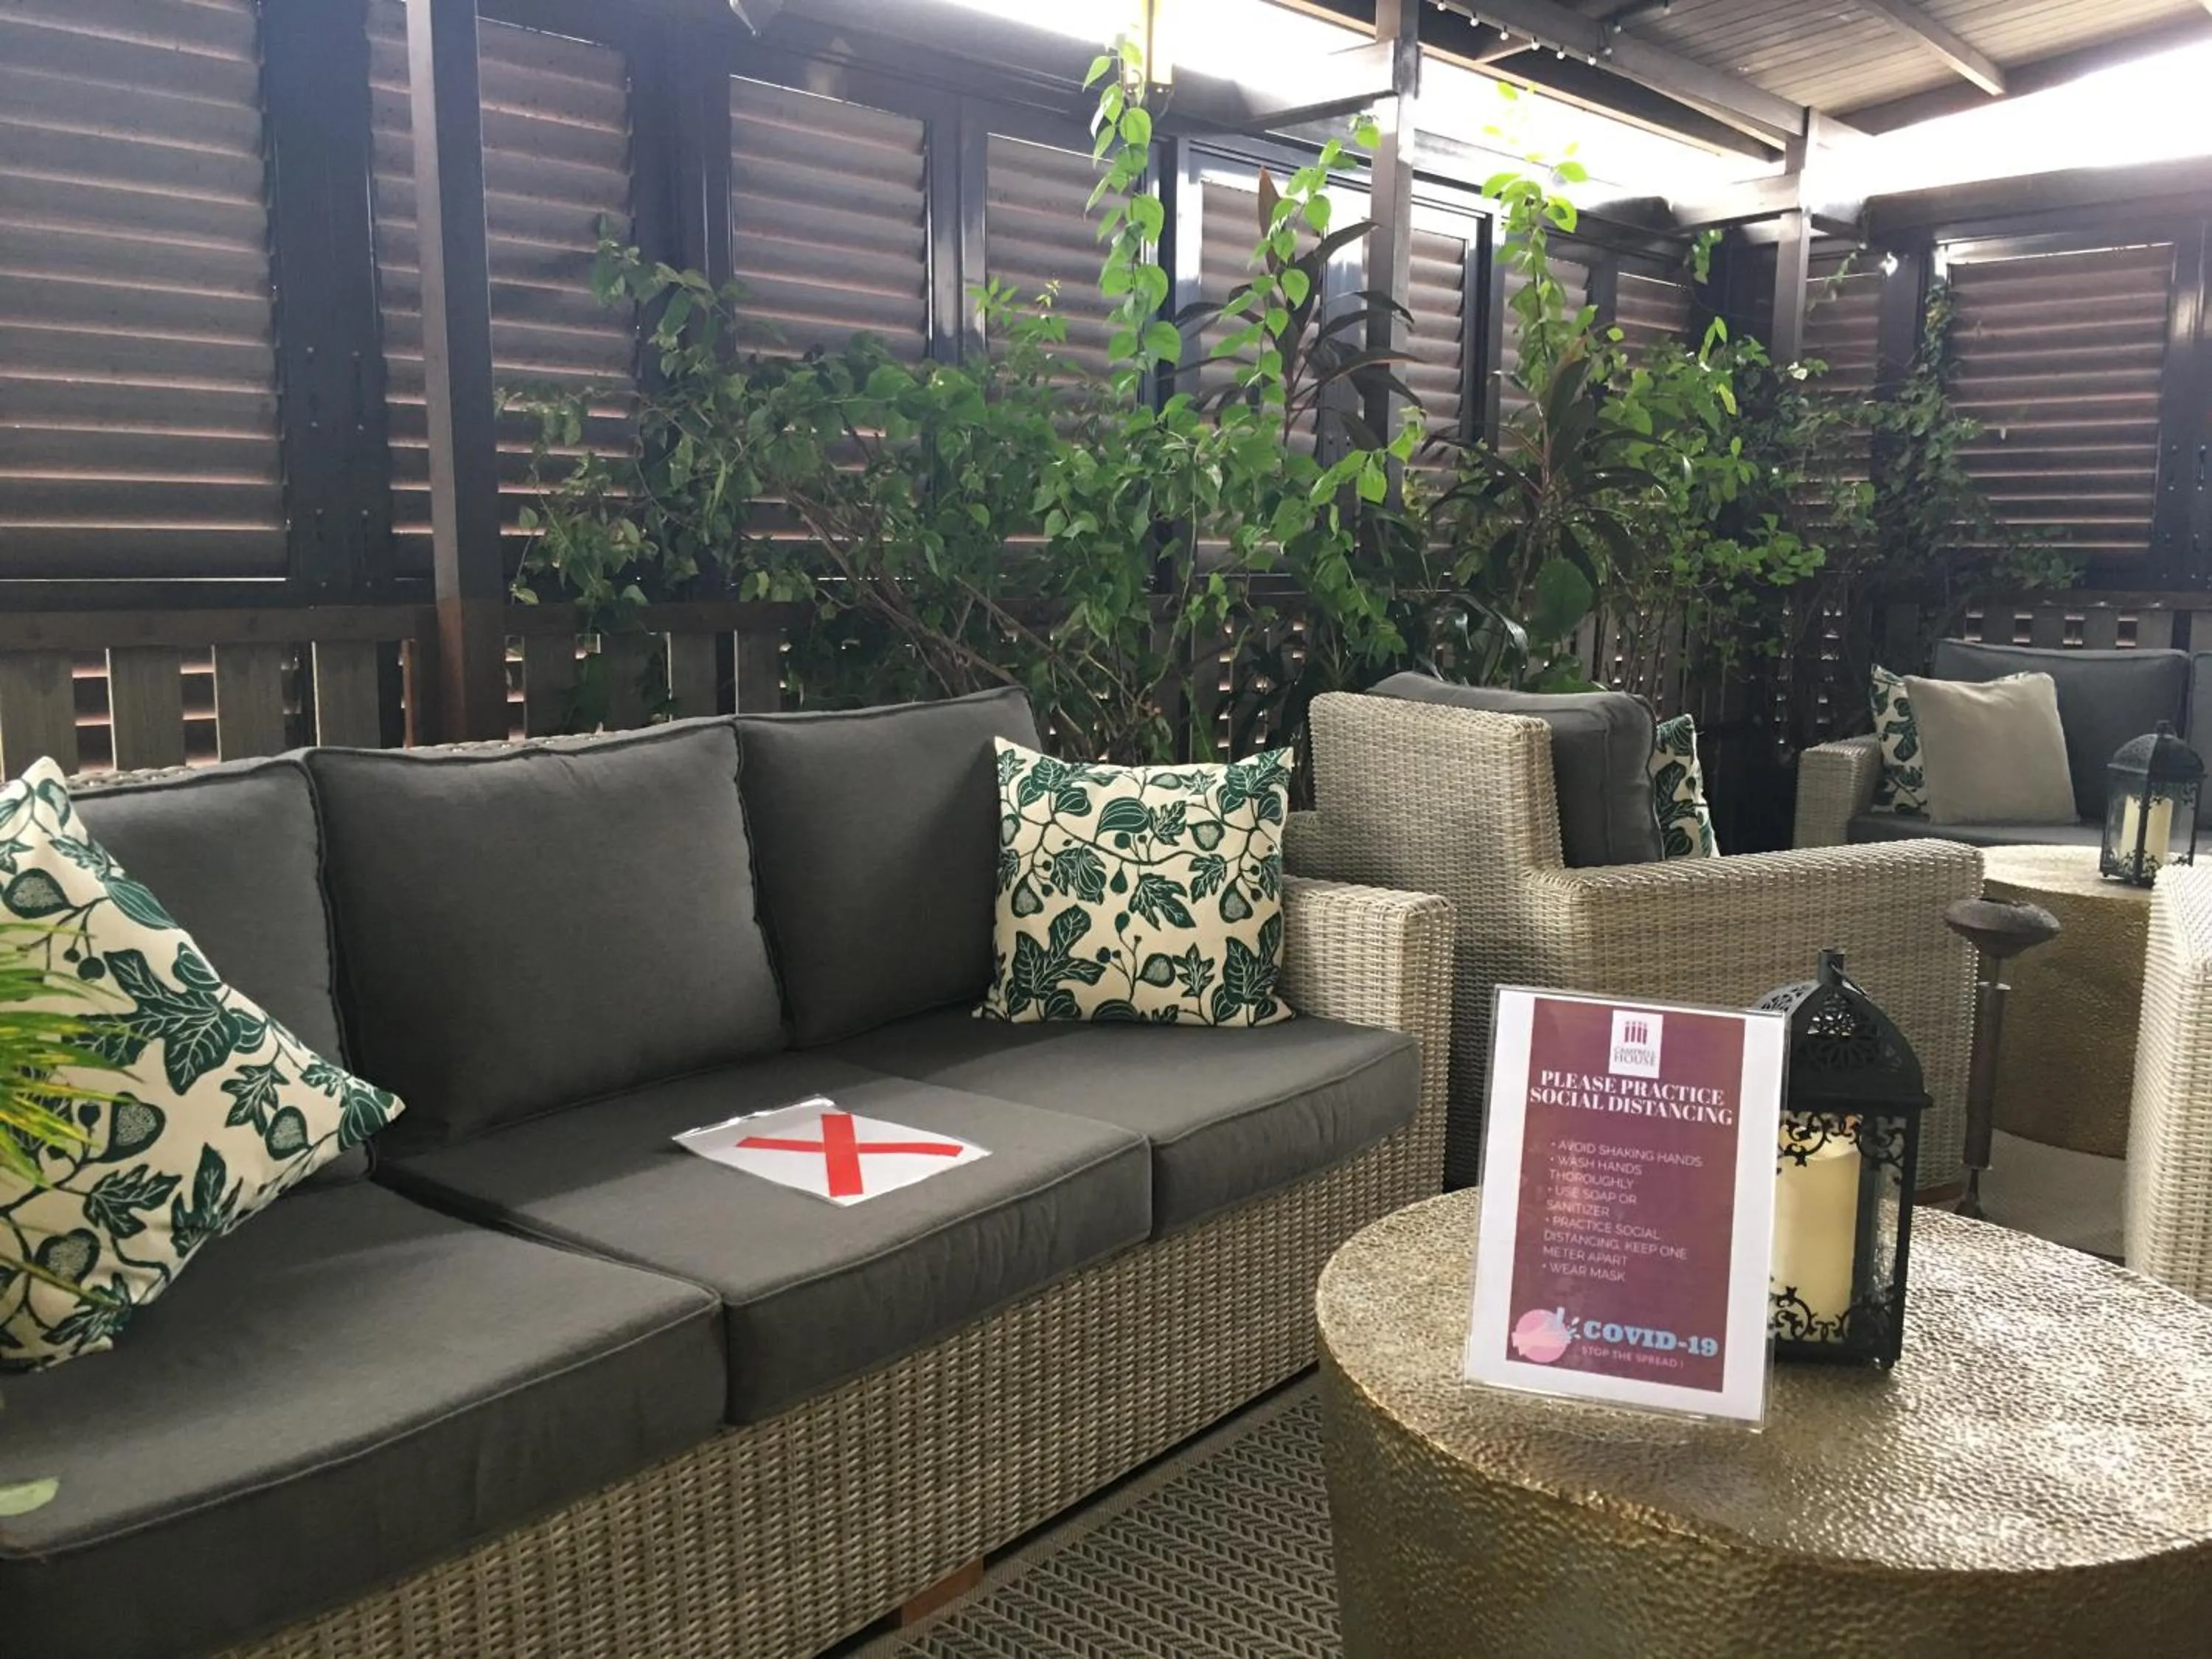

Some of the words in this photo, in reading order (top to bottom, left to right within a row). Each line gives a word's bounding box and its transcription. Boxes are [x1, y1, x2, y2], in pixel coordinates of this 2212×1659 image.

[1613, 1052, 1655, 1067] HOUSE
[1540, 1070, 1616, 1094] PLEASE
[1621, 1079, 1725, 1106] PRACTICE
[1529, 1087, 1604, 1110] SOCIAL
[1608, 1096, 1733, 1125] DISTANCING
[1557, 1140, 1596, 1155] AVOID
[1598, 1144, 1654, 1161] SHAKING
[1657, 1152, 1703, 1167] HANDS
[1557, 1155, 1595, 1169] WASH
[1598, 1161, 1642, 1176] HANDS
[1549, 1169, 1634, 1190] THOROUGHLY
[1555, 1185, 1579, 1199] USE
[1582, 1188, 1616, 1203] SOAP
[1618, 1193, 1638, 1205] OR
[1546, 1199, 1610, 1217] SANITIZER
[1552, 1215, 1612, 1234] PRACTICE
[1615, 1223, 1661, 1240] SOCIAL
[1543, 1245, 1585, 1262] METER
[1587, 1251, 1628, 1267] APART
[1624, 1241, 1658, 1254] KEEP
[1659, 1245, 1688, 1260] ONE
[1549, 1262, 1587, 1276] WEAR
[1590, 1267, 1626, 1282] MASK
[1583, 1320, 1719, 1357] COVID-19
[1582, 1346, 1610, 1358] STOP
[1613, 1350, 1632, 1362] THE
[1636, 1353, 1678, 1368] SPREAD
